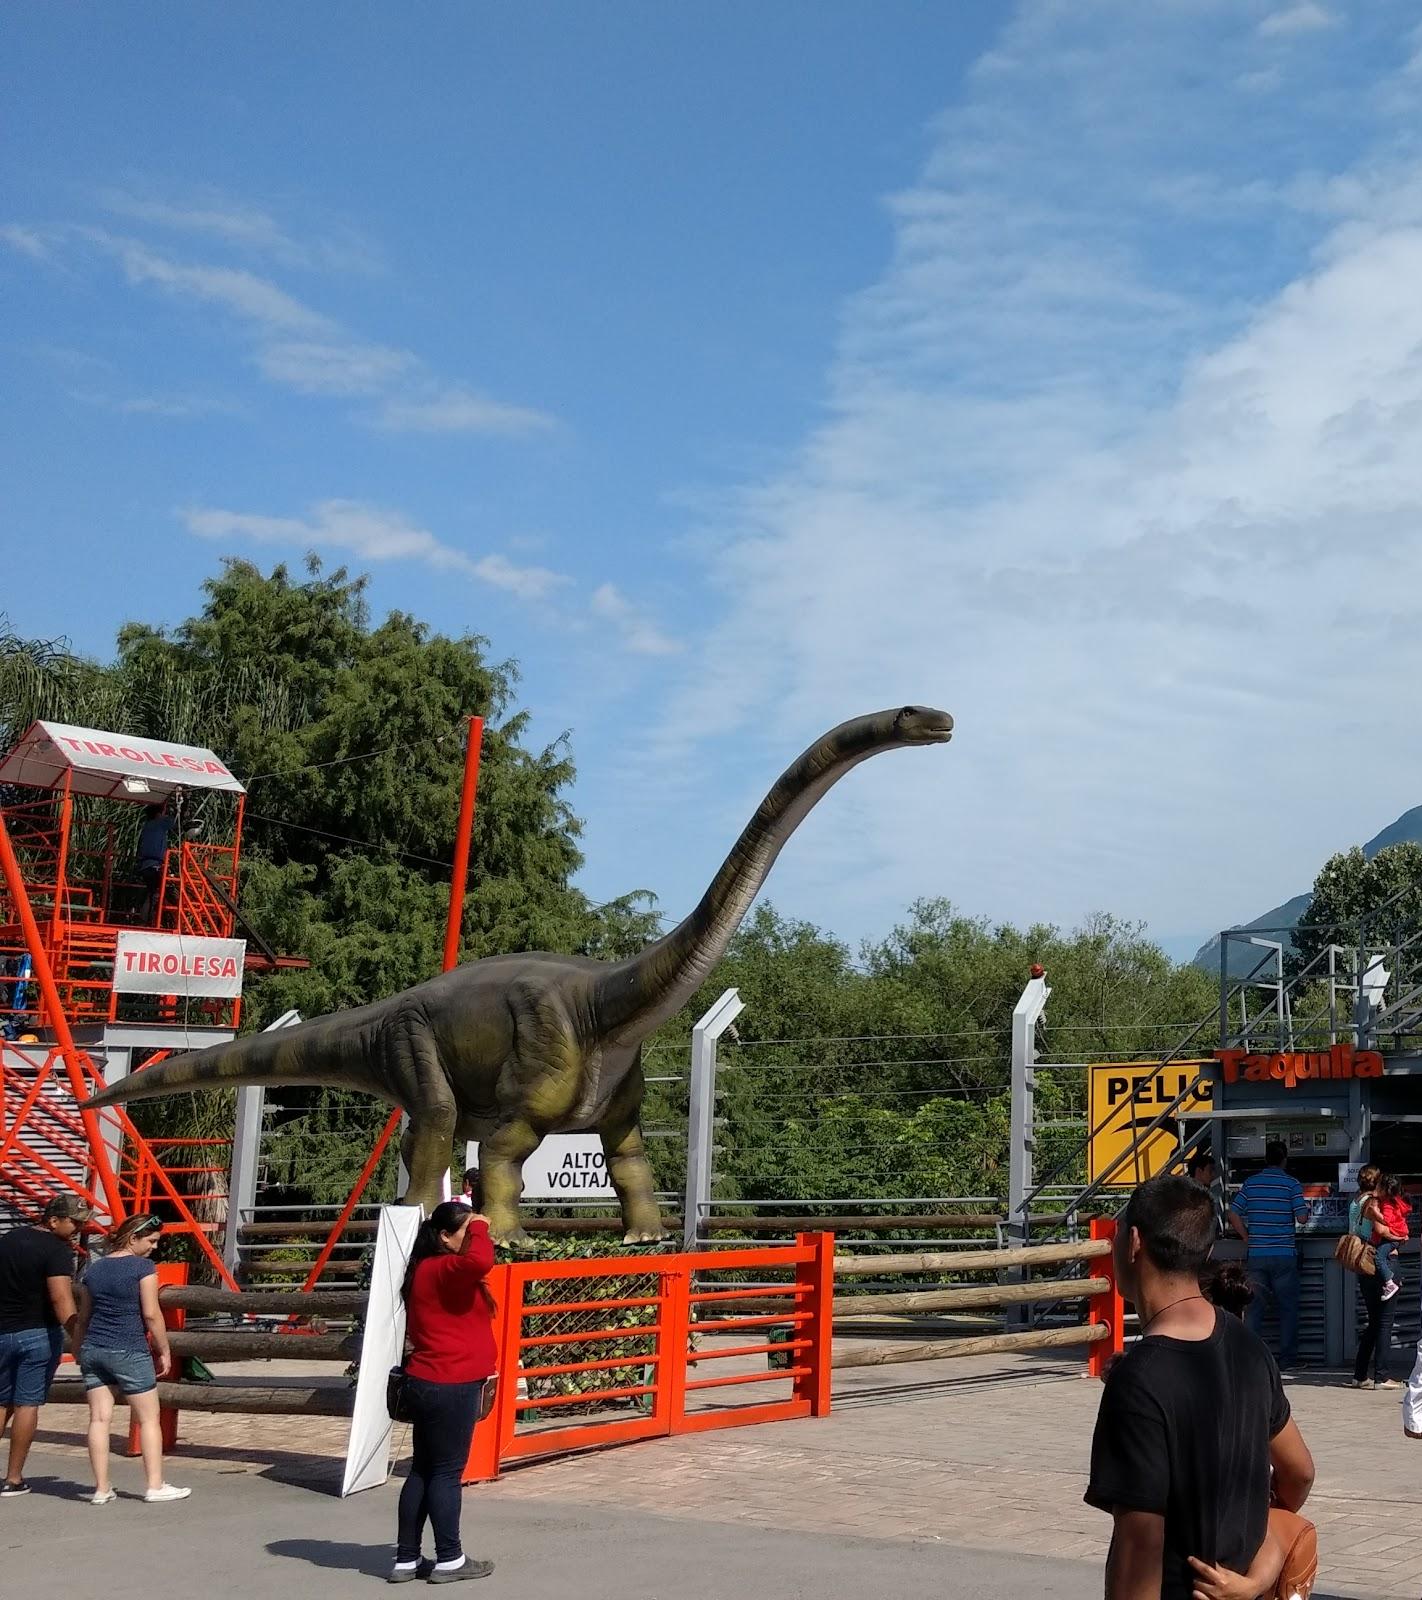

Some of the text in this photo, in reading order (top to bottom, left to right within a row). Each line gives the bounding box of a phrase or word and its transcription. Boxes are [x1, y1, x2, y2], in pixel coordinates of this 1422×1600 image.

[59, 736, 230, 777] TIROLESA
[122, 950, 238, 978] TIROLESA
[1213, 1044, 1385, 1088] Taquilla
[562, 1152, 605, 1169] ALTO
